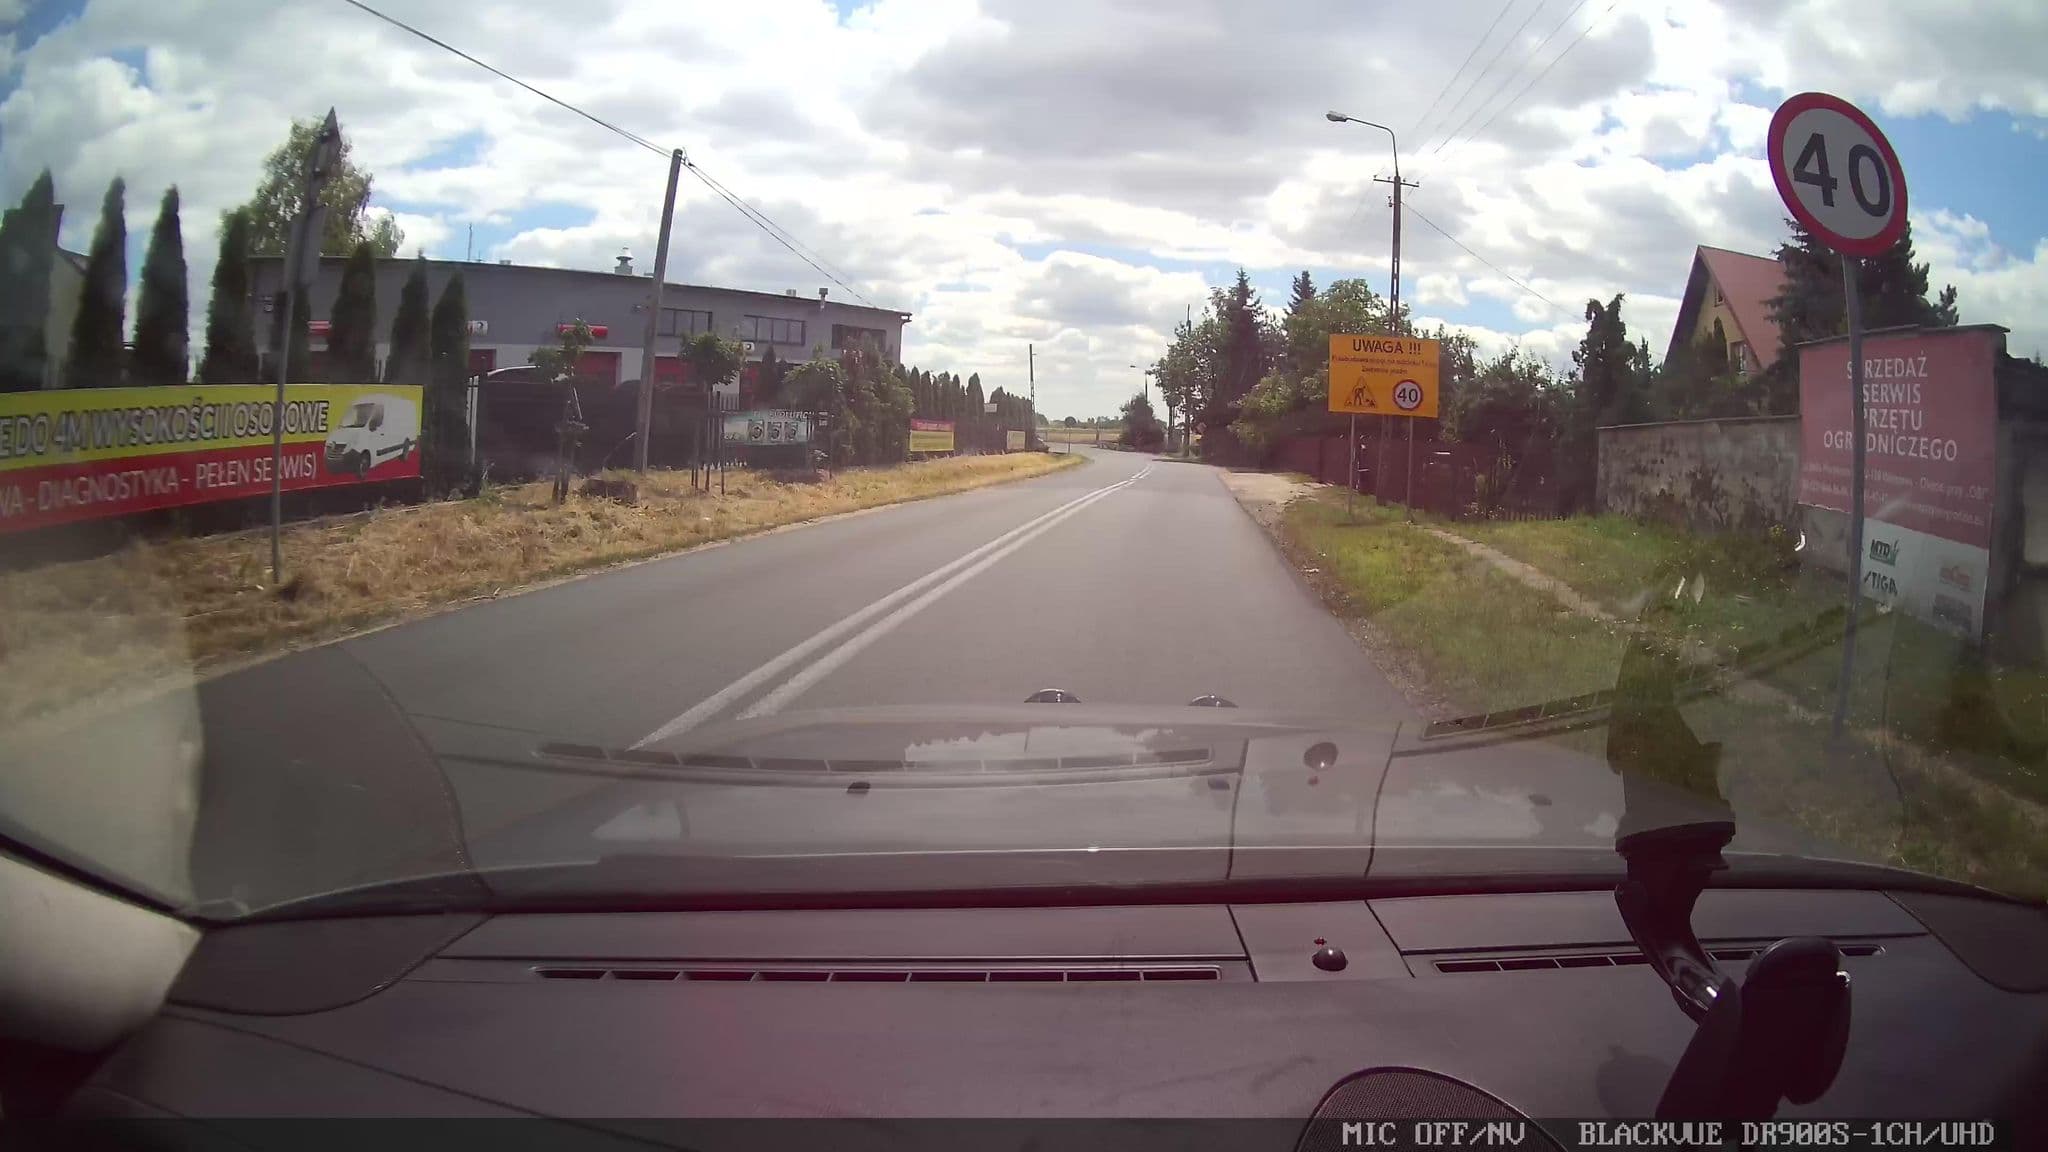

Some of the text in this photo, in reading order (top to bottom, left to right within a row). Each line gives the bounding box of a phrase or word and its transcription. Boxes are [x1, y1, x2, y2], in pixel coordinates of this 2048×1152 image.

[1792, 132, 1891, 217] 40
[1352, 338, 1421, 355] UWAGA !!!
[1847, 351, 1928, 380] SRZEDAŻ
[1397, 387, 1419, 403] 40
[15, 412, 50, 457] DO
[233, 399, 330, 438] OSOOWE
[1823, 430, 1958, 462] OGRDNICZEGO
[38, 466, 179, 512] DIAGNOSTYKA
[196, 459, 250, 489] PEŁEN
